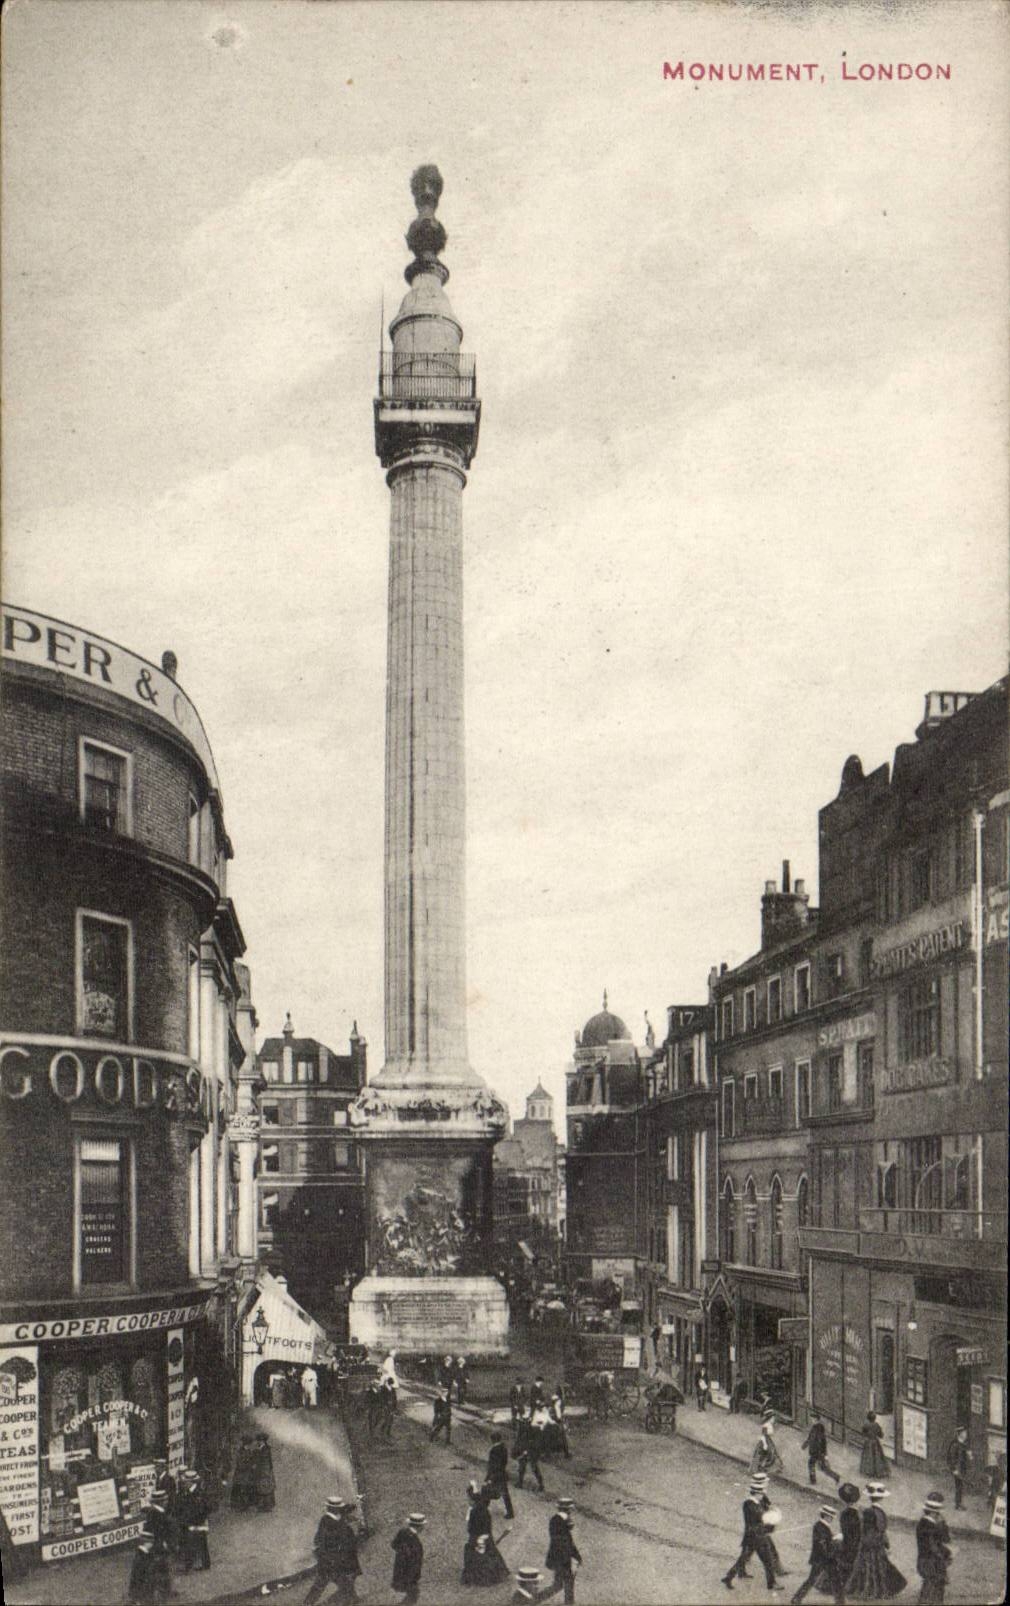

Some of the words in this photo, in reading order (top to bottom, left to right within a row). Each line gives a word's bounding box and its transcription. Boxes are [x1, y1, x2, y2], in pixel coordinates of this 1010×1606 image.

[136, 668, 158, 706] &
[15, 1318, 110, 1341] COOPER
[116, 1309, 177, 1331] COOPER
[0, 1444, 36, 1459] TEAS
[51, 1537, 98, 1557] COOPER
[102, 1525, 140, 1545] COOPER
